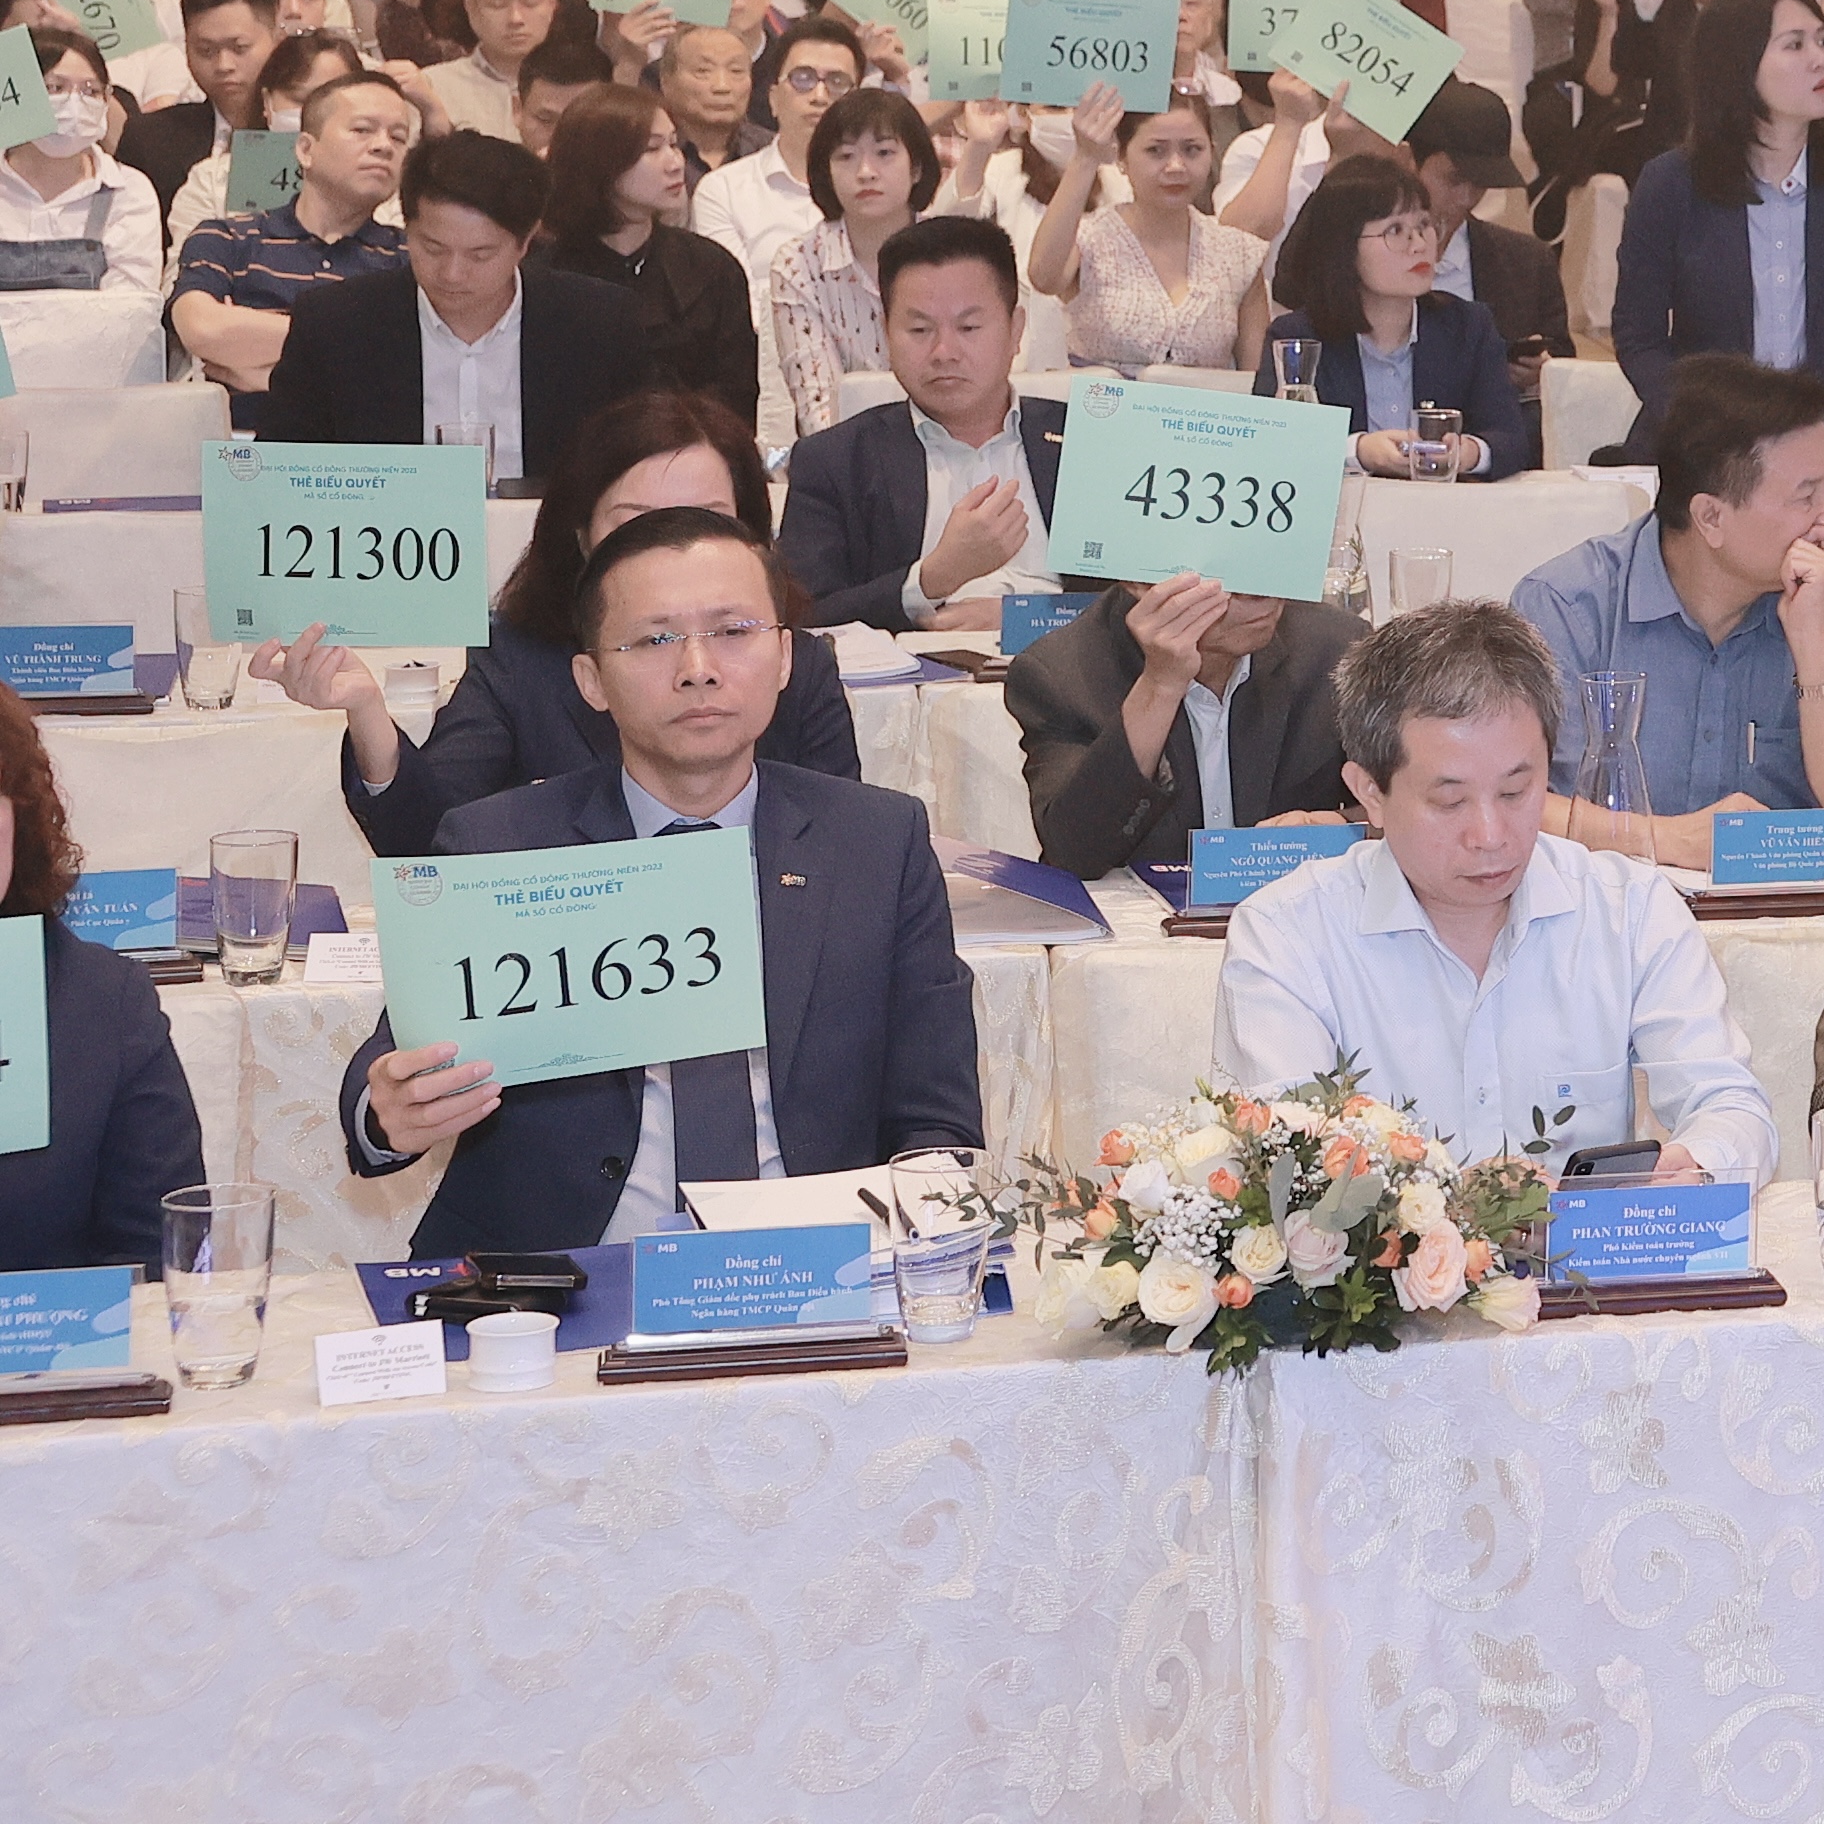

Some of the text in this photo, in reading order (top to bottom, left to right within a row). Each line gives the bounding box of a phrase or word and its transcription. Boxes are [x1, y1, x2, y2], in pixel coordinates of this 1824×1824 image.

[1047, 36, 1148, 73] 56803
[1321, 21, 1416, 97] 82054
[1104, 386, 1124, 397] MB
[1161, 418, 1184, 431] THẺ
[1217, 425, 1256, 439] QUYẾT
[233, 449, 250, 459] MB
[1125, 465, 1296, 533] 43338
[259, 524, 459, 581] 121300
[1767, 825, 1794, 836] Trung
[1251, 840, 1308, 852] Thiếu tướng
[642, 862, 663, 872] 2023
[1230, 855, 1298, 866] NGÔ QUANG
[412, 865, 438, 878] MB
[494, 880, 624, 906] THẺ BIỂU QUYẾT
[455, 927, 721, 1020] 121633
[1569, 1199, 1586, 1210] MB
[1624, 1204, 1676, 1220] Đồng chí
[1572, 1220, 1727, 1240] PHAN TRƯỜNG GIANG
[657, 1243, 678, 1254] MB
[724, 1254, 782, 1270] Đồng chí
[693, 1269, 812, 1292] PHẠM NHƯ ÁNH
